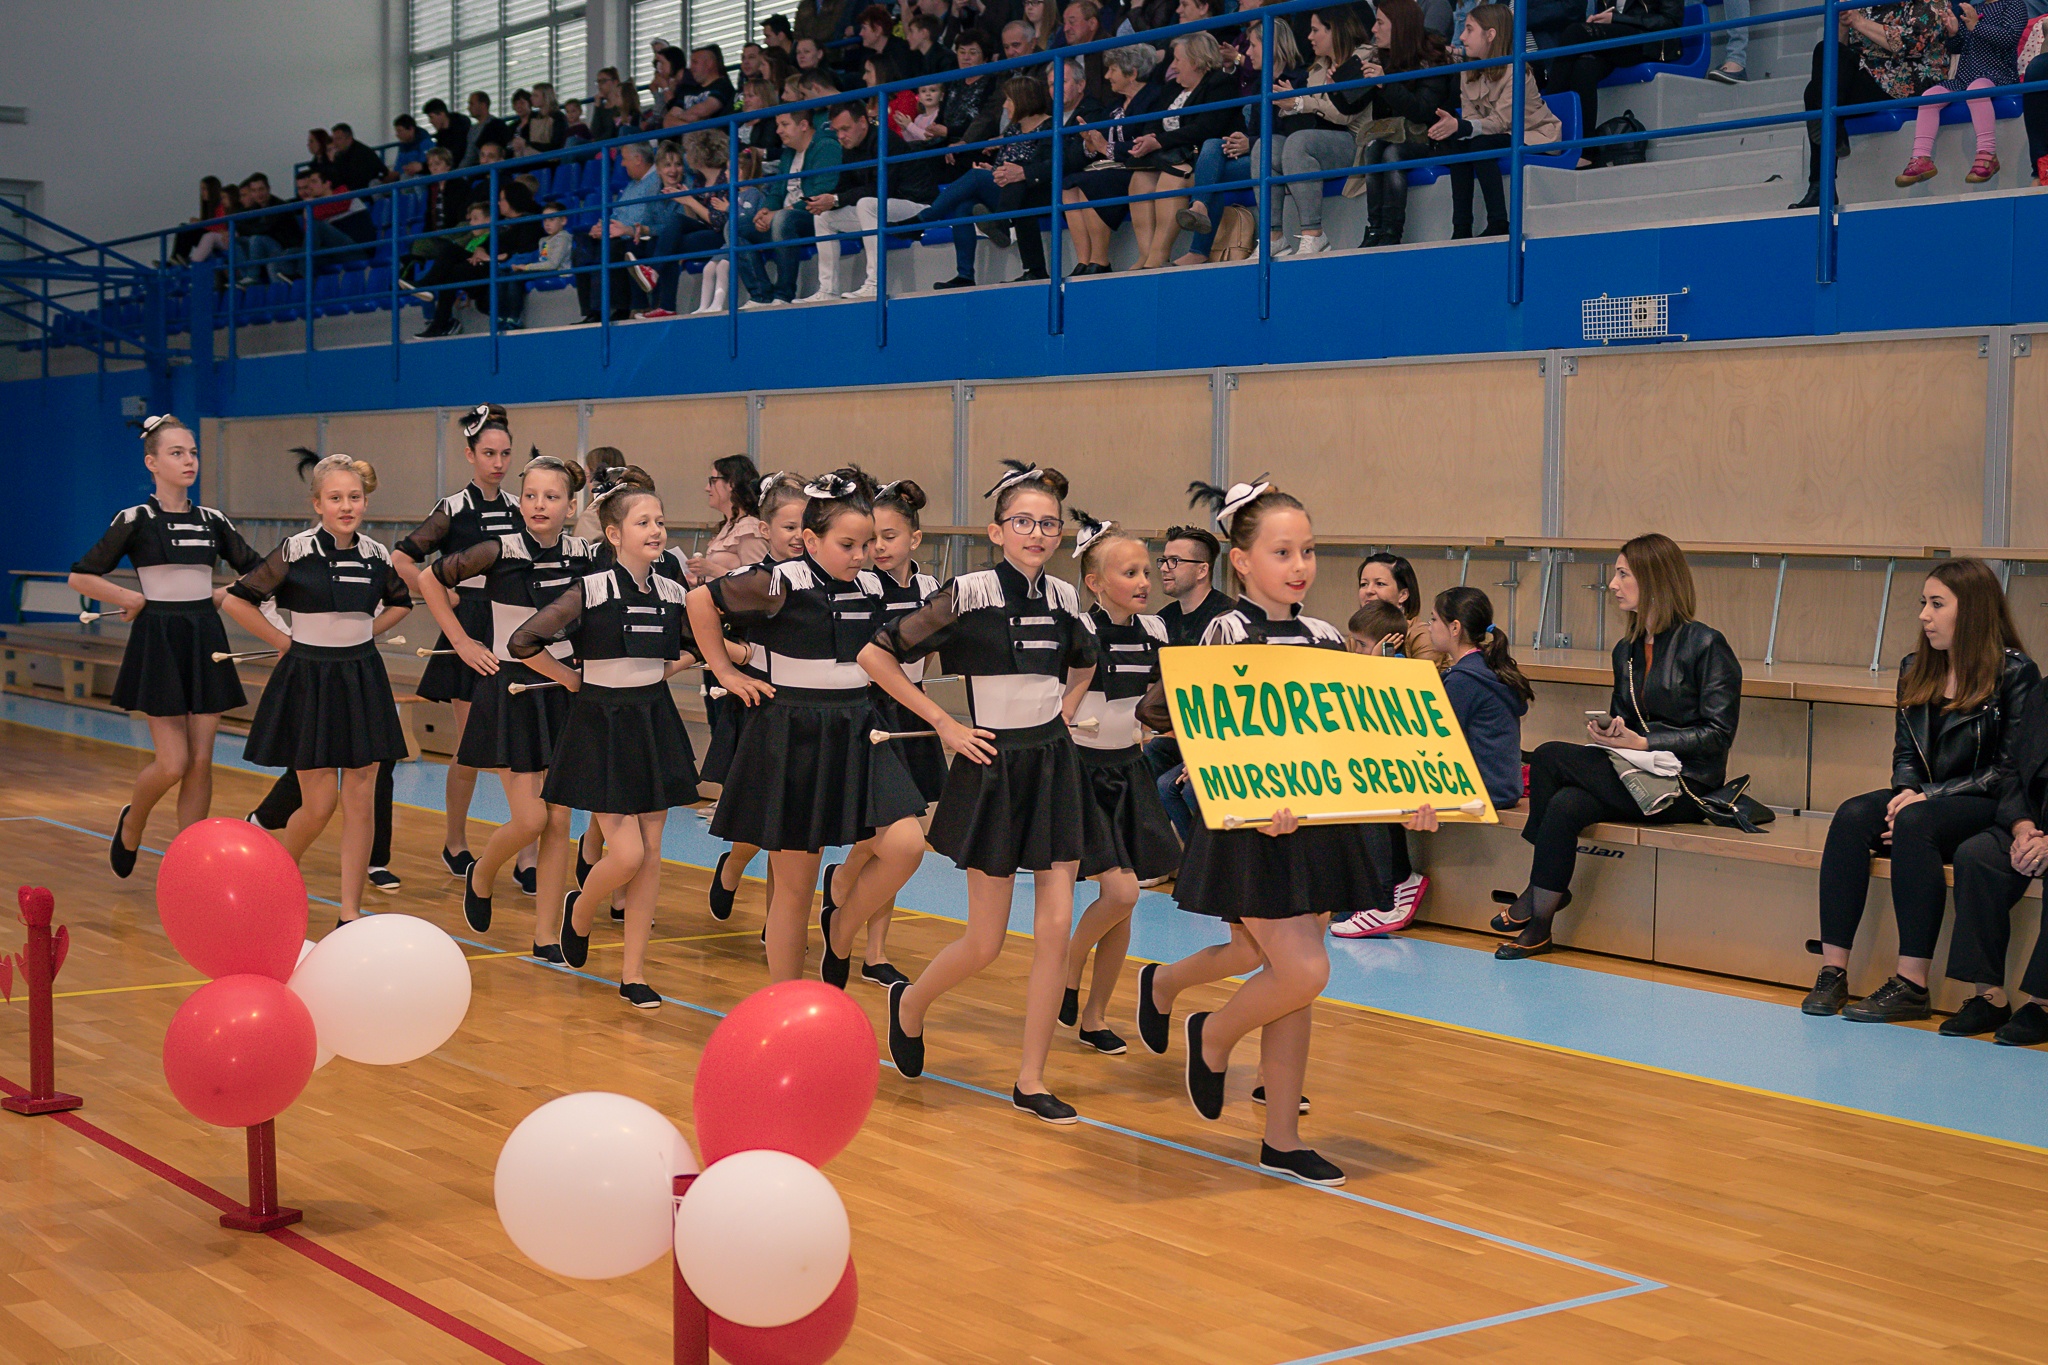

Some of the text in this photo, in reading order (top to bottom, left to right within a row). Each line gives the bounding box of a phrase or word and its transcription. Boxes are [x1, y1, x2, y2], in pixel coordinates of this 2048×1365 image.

[1175, 665, 1451, 741] MAŽORETKINJE
[1199, 750, 1477, 801] MURSKOG SREDIŠĆA
[1576, 845, 1625, 858] elan
